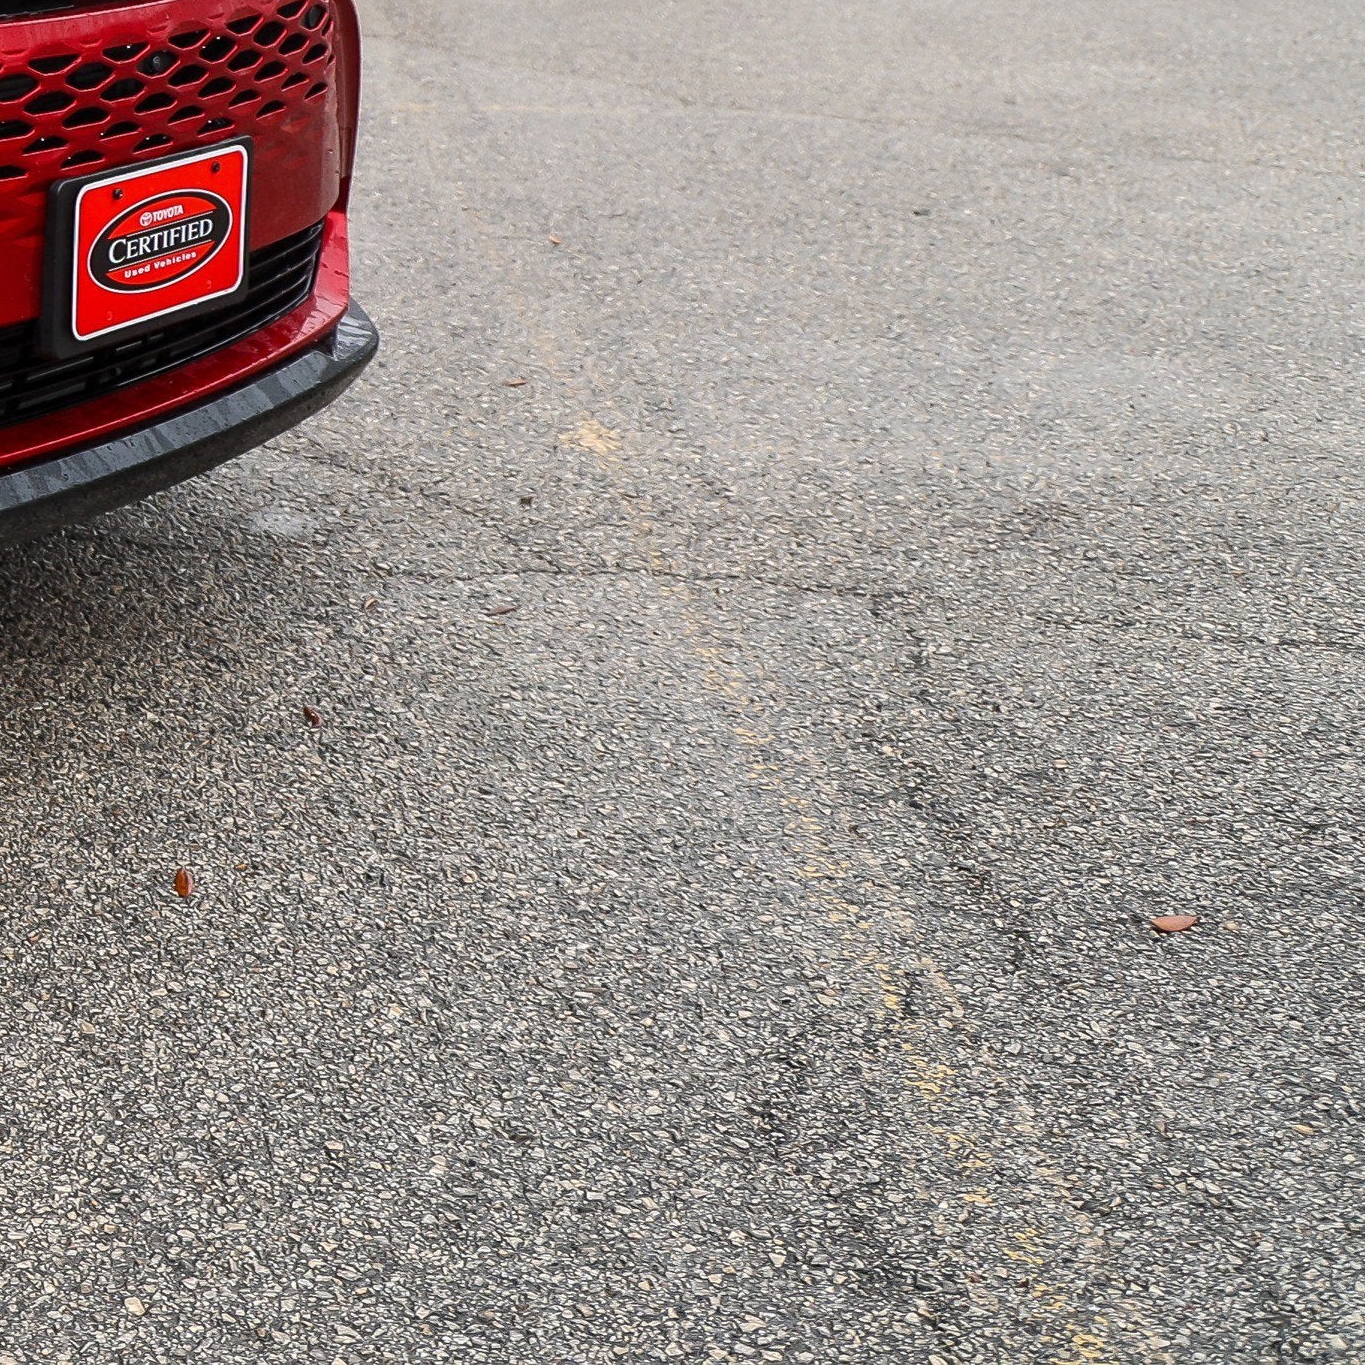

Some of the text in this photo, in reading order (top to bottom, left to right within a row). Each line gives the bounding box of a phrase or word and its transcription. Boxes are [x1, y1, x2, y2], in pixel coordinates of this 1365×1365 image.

[151, 204, 184, 223] TOYOTA
[108, 218, 214, 264] CERTIFIED
[124, 251, 197, 279] Used Vehicles
